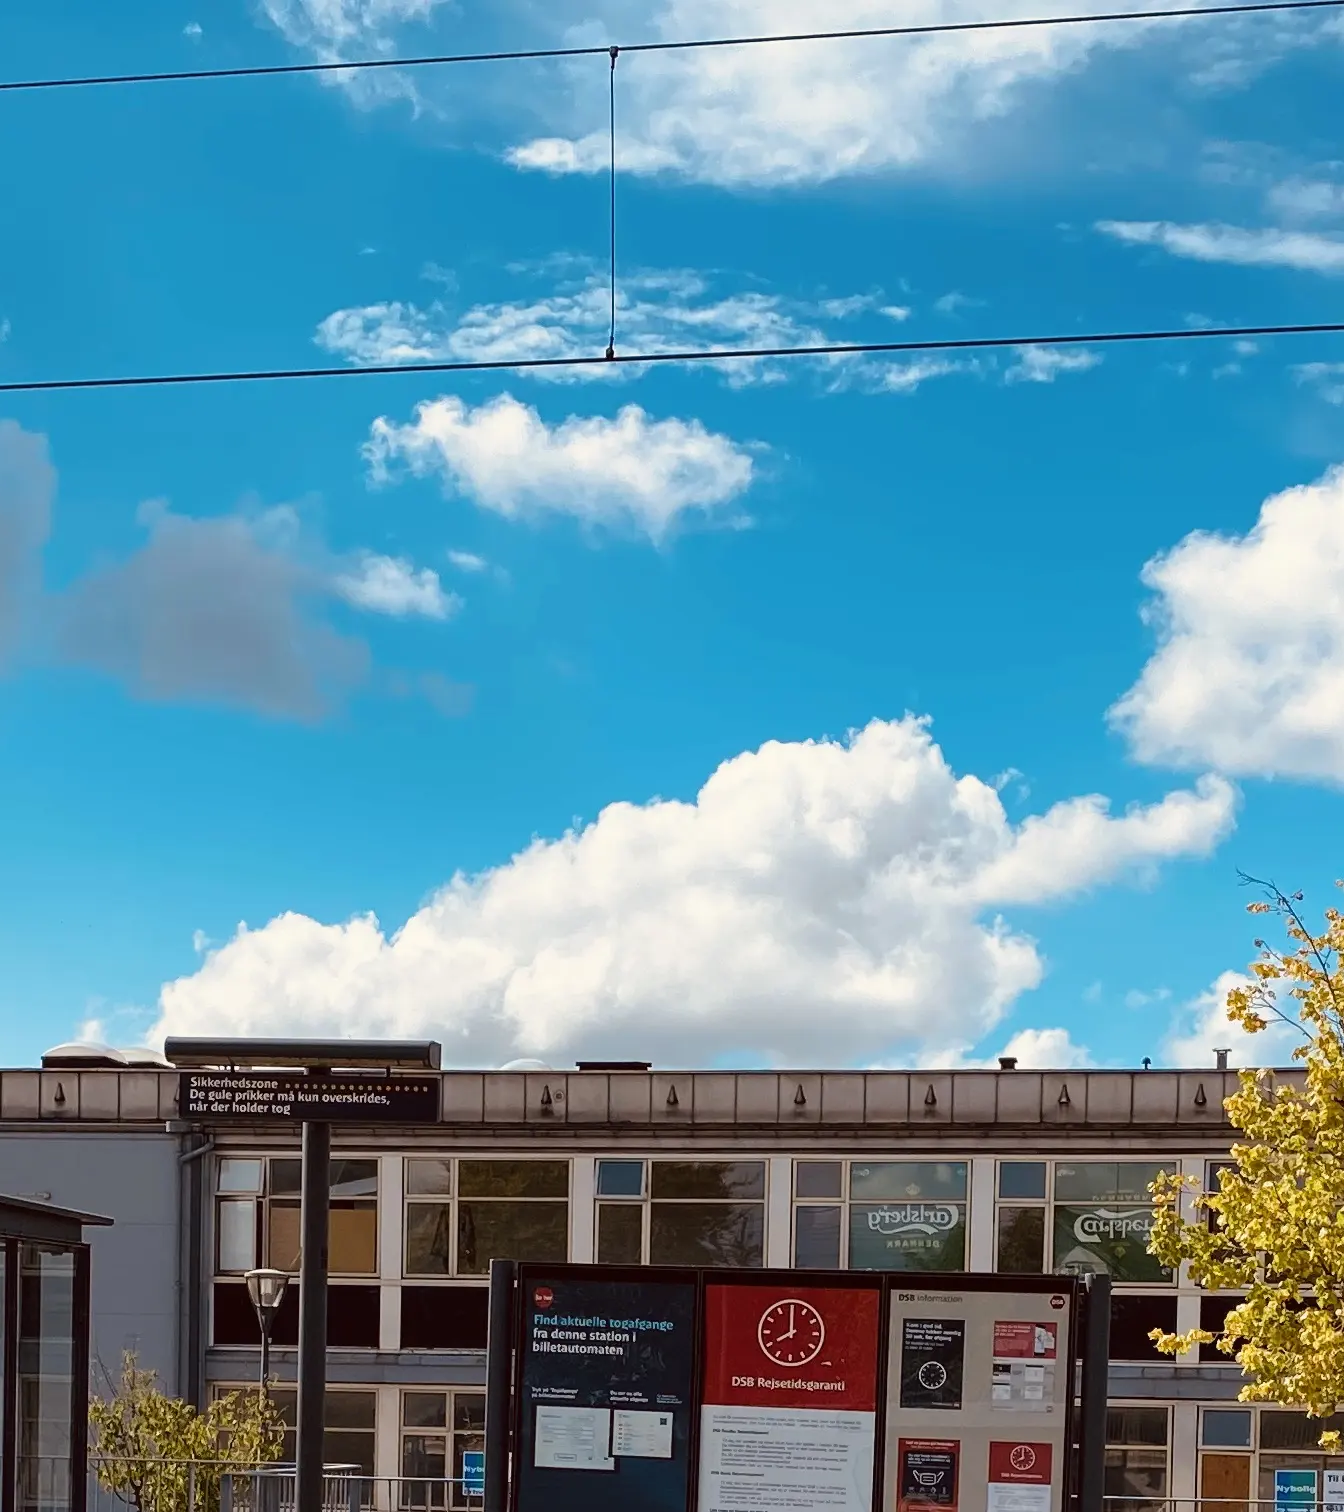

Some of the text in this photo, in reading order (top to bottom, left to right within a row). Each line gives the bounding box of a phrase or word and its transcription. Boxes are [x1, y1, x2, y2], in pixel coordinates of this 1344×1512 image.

[189, 1076, 279, 1090] Sikkerhedszone
[189, 1089, 391, 1106] De gule prikker må kun overskrides,
[189, 1101, 291, 1116] når der holder tog
[898, 1293, 963, 1303] DSB information
[534, 1314, 674, 1332] Find aktuelle togafgange
[533, 1328, 637, 1343] fra denne station i
[532, 1341, 624, 1356] billetautomaten
[731, 1376, 846, 1392] DSB Rejsetidsgaranti
[1328, 1475, 1340, 1483] Til
[1275, 1485, 1316, 1494] Nybolig
